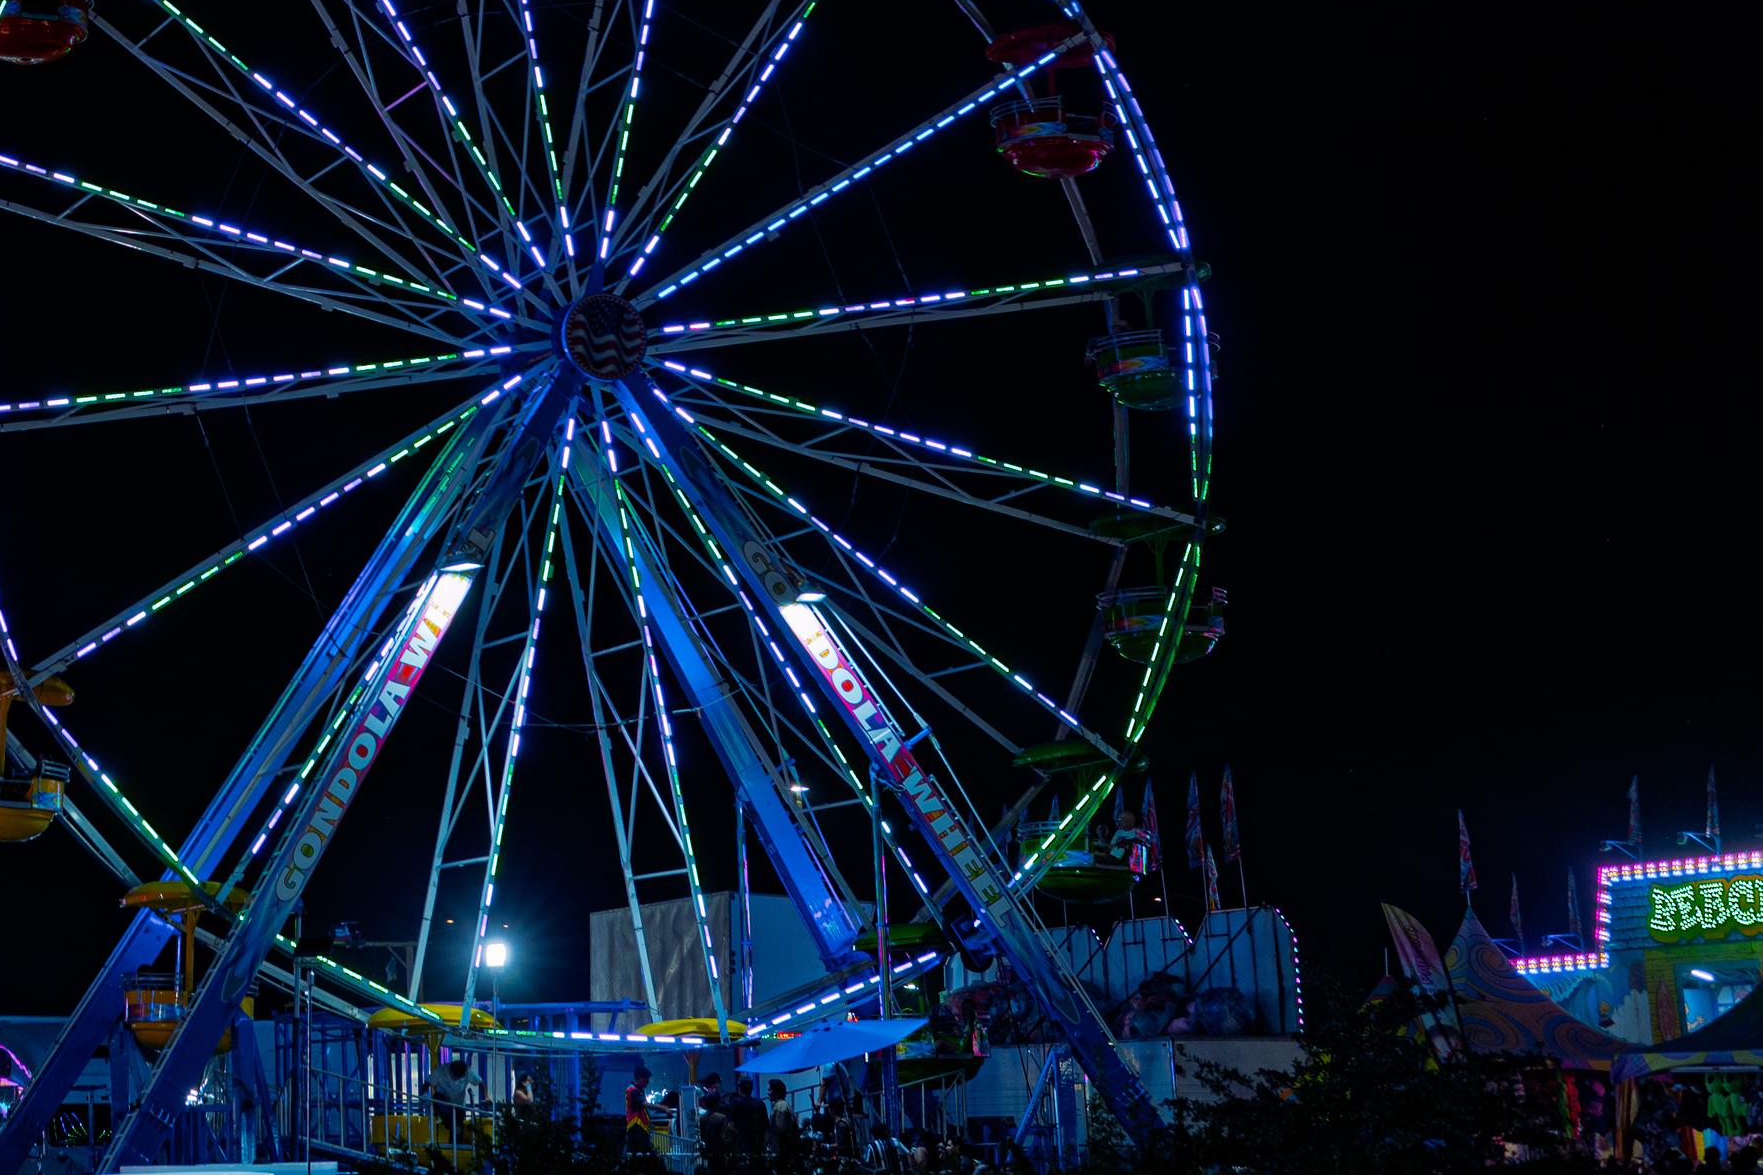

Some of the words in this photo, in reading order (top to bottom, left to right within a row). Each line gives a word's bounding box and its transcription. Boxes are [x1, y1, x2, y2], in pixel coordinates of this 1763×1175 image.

[275, 679, 411, 902] GONDOLA
[401, 527, 496, 671] WHL
[742, 539, 903, 765] GODOLA
[902, 765, 1014, 929] WHEEL
